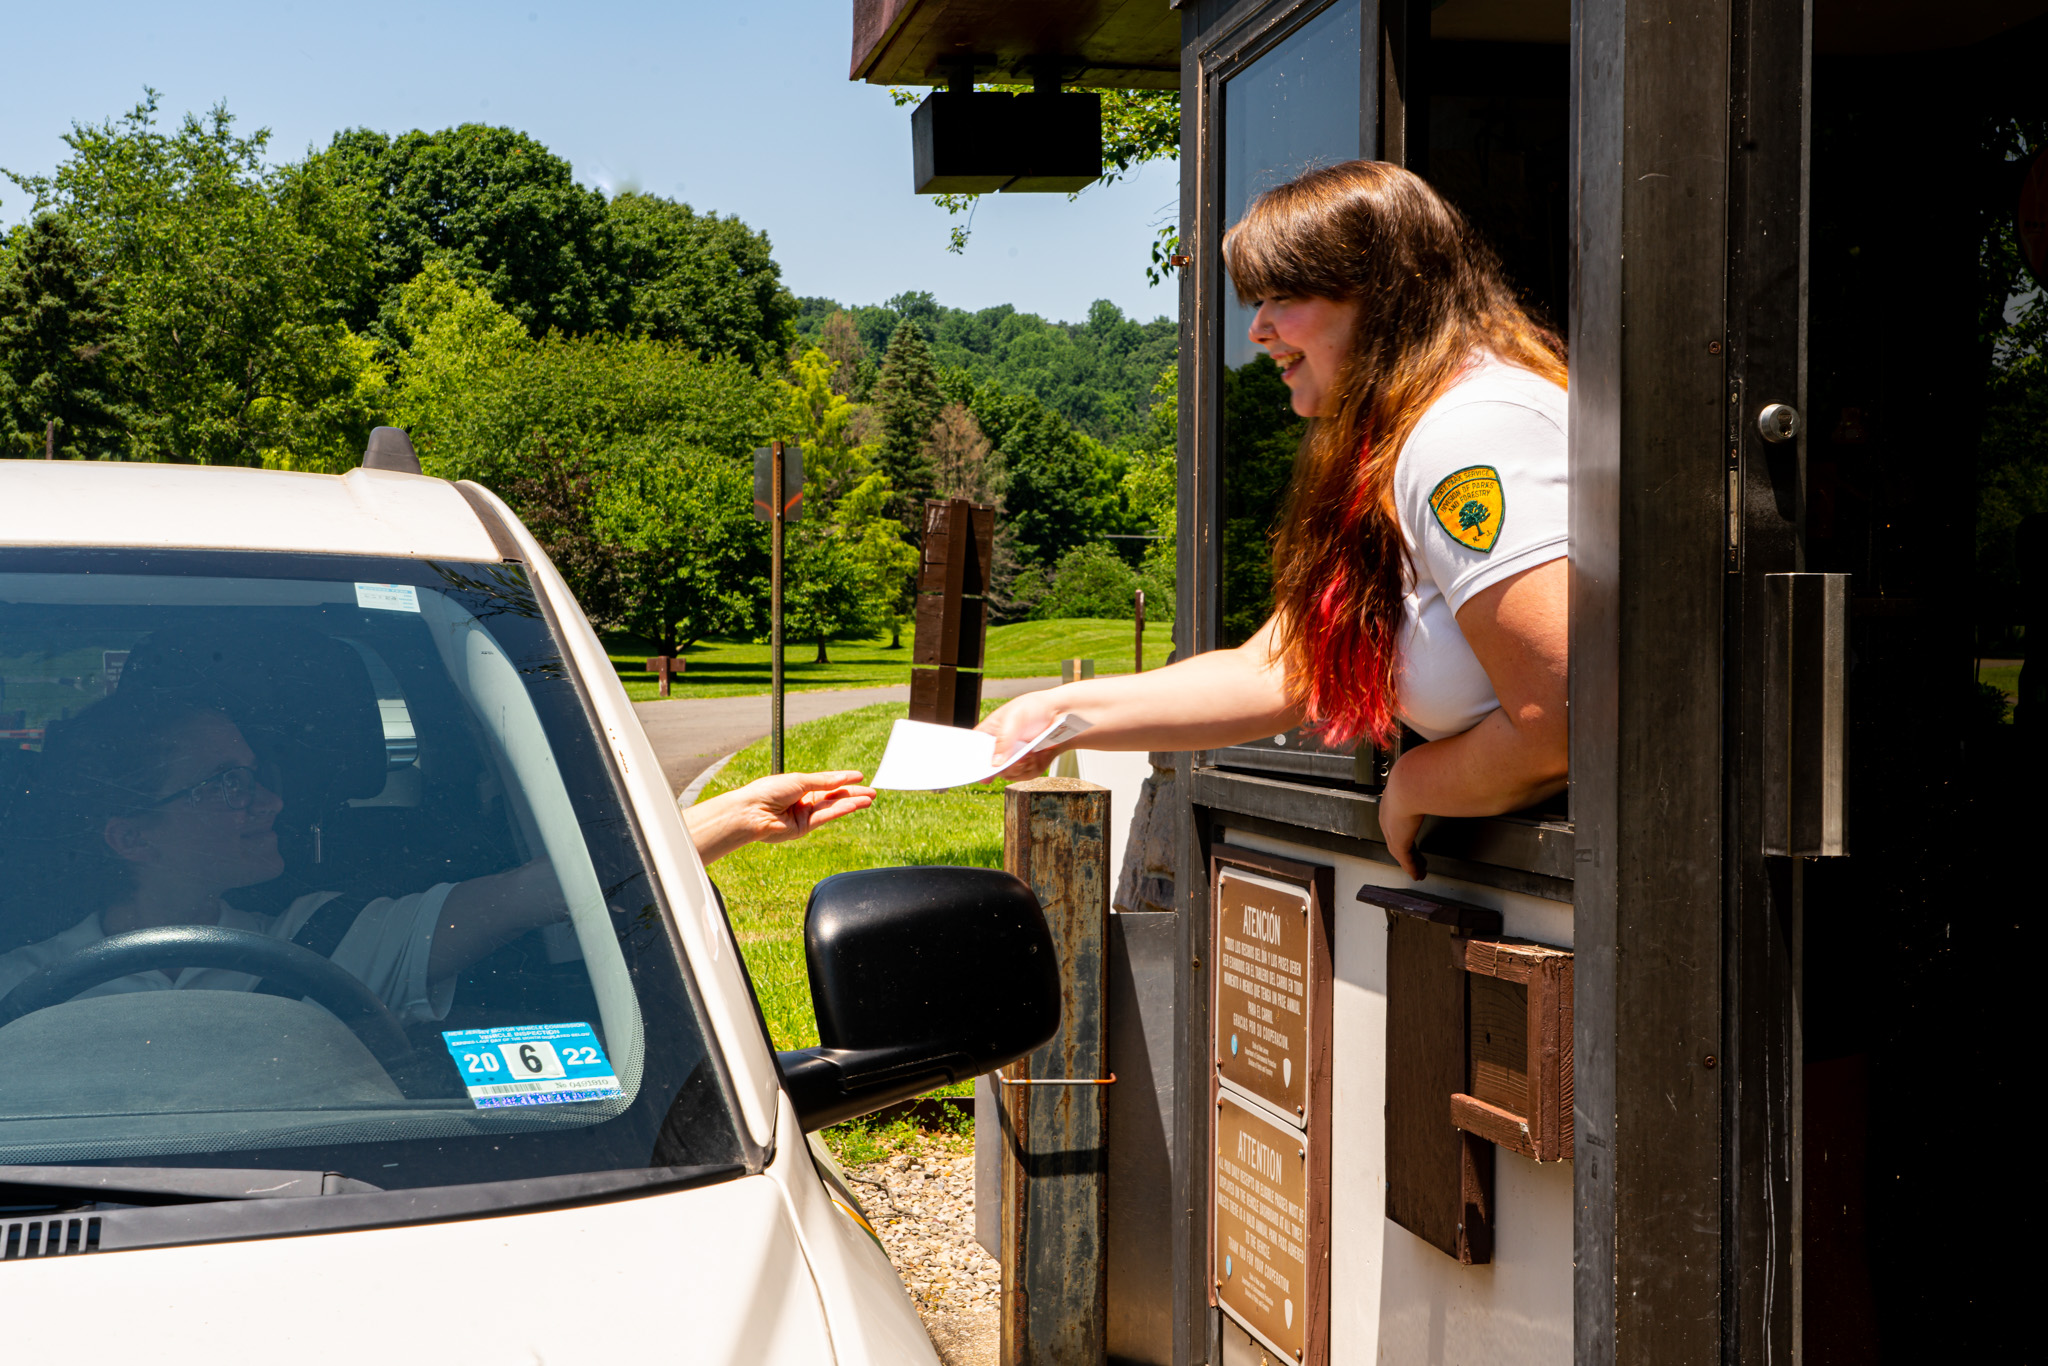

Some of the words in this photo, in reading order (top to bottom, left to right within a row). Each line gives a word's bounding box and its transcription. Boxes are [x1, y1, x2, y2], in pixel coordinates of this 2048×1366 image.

[1435, 485, 1448, 501] STATE
[1447, 475, 1462, 487] PARK
[1464, 470, 1489, 478] SERVICE
[1440, 490, 1460, 513] DIVISION
[1462, 484, 1470, 492] OF
[1448, 500, 1460, 514] AND
[1460, 490, 1491, 503] FORESTRY
[1243, 906, 1280, 946] ATENCIÓN
[1246, 961, 1250, 976] EN
[1251, 964, 1255, 978] EL
[1277, 973, 1288, 991] CARRO
[1288, 978, 1293, 993] EN
[1294, 980, 1303, 997] TODO
[1278, 955, 1289, 972] PASES
[1290, 959, 1302, 977] DEBEN
[1248, 1000, 1256, 1017] PARA
[1256, 1004, 1261, 1019] EL
[479, 1032, 512, 1040] VEHICLE
[514, 1029, 560, 1037] INSPECTION
[1233, 1012, 1248, 1031] GRACIAS
[1257, 1023, 1262, 1038] SU
[463, 1052, 500, 1073] 20
[519, 1044, 543, 1073] 6
[562, 1046, 601, 1065] 22
[1238, 1130, 1282, 1185] ATTENTION
[1246, 1192, 1259, 1213] VEHICLE
[1279, 1215, 1284, 1230] AT
[1291, 1222, 1303, 1243] TIMES
[1274, 1192, 1288, 1213] PASSES
[1299, 1208, 1304, 1224] BE
[1245, 1229, 1250, 1245] TO
[1269, 1227, 1277, 1246] PARK
[1278, 1233, 1288, 1252] PASS
[1228, 1235, 1239, 1255] THANK
[1246, 1250, 1254, 1267] FOR
[1254, 1255, 1264, 1274] YOUR
